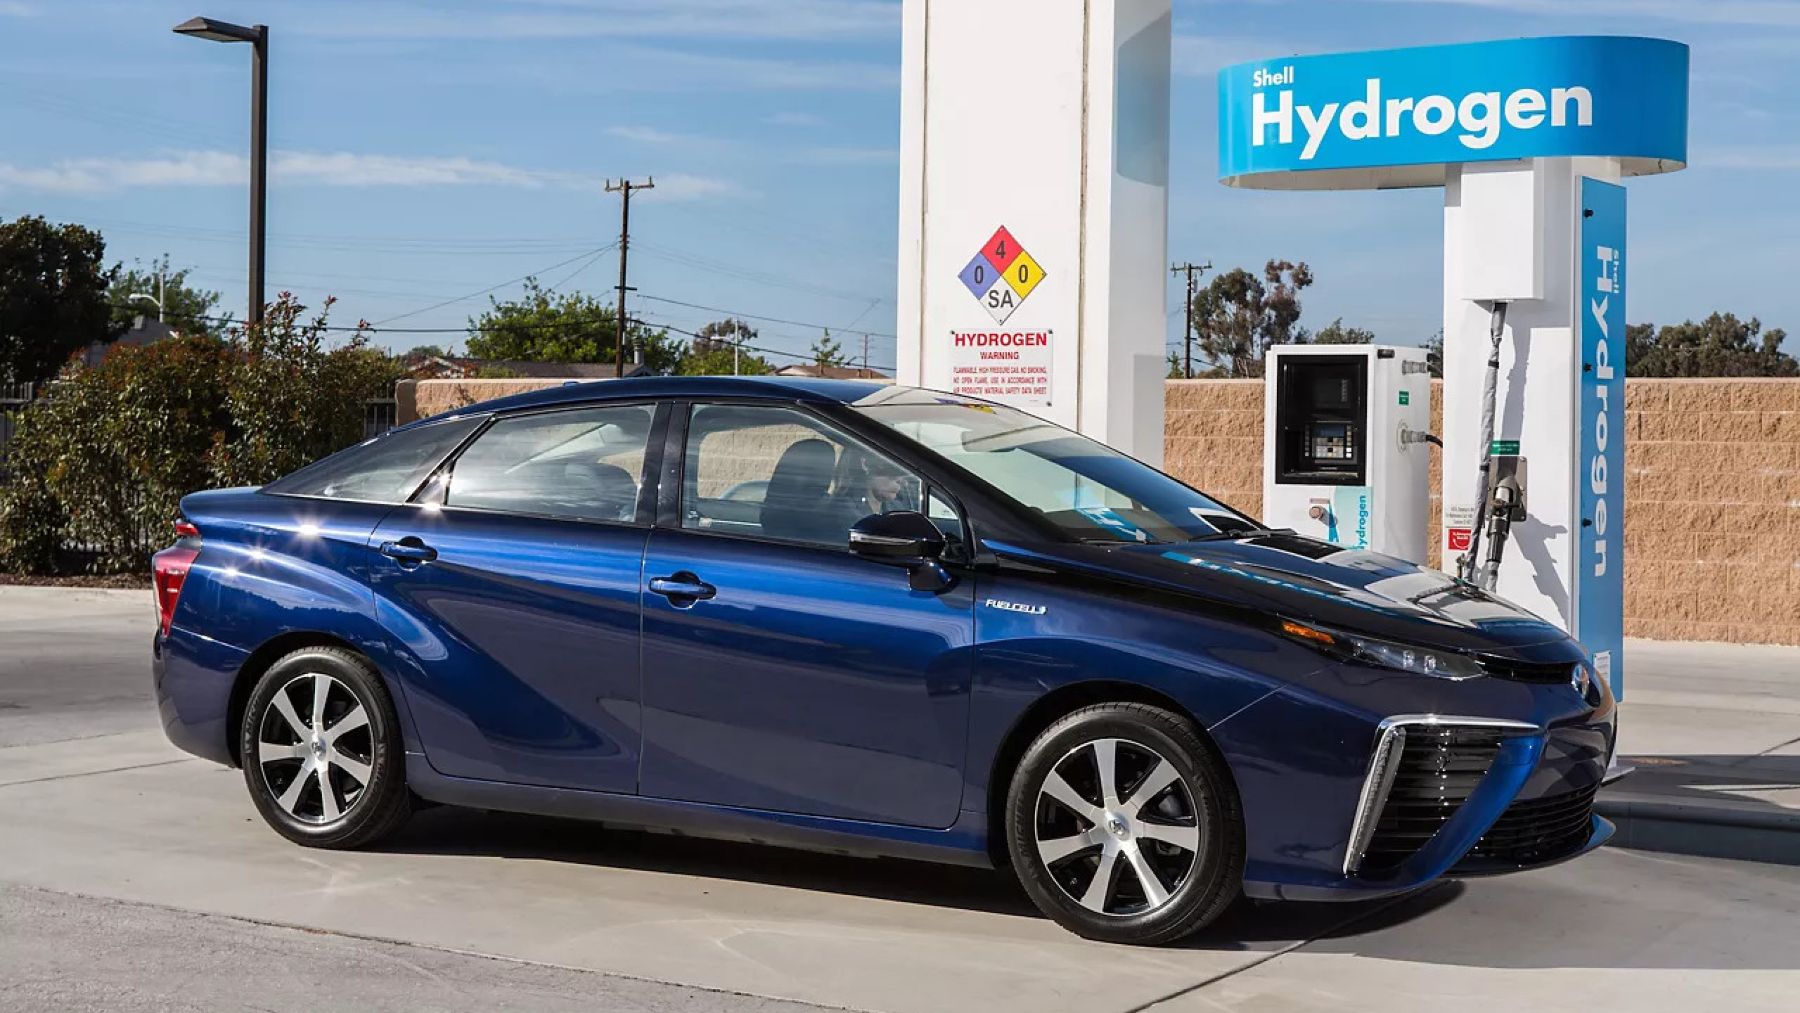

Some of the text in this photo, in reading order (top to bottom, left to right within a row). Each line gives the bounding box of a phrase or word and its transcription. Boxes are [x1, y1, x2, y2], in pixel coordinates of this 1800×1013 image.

[1253, 66, 1294, 87] Shell
[1252, 78, 1593, 160] Hydrogen
[995, 240, 1006, 259] 4
[974, 264, 1029, 284] 0 0
[988, 289, 1014, 308] SA
[954, 333, 1047, 347] HYDROGEN
[979, 351, 1020, 360] WARNING
[1591, 245, 1614, 577] Hydrogen
